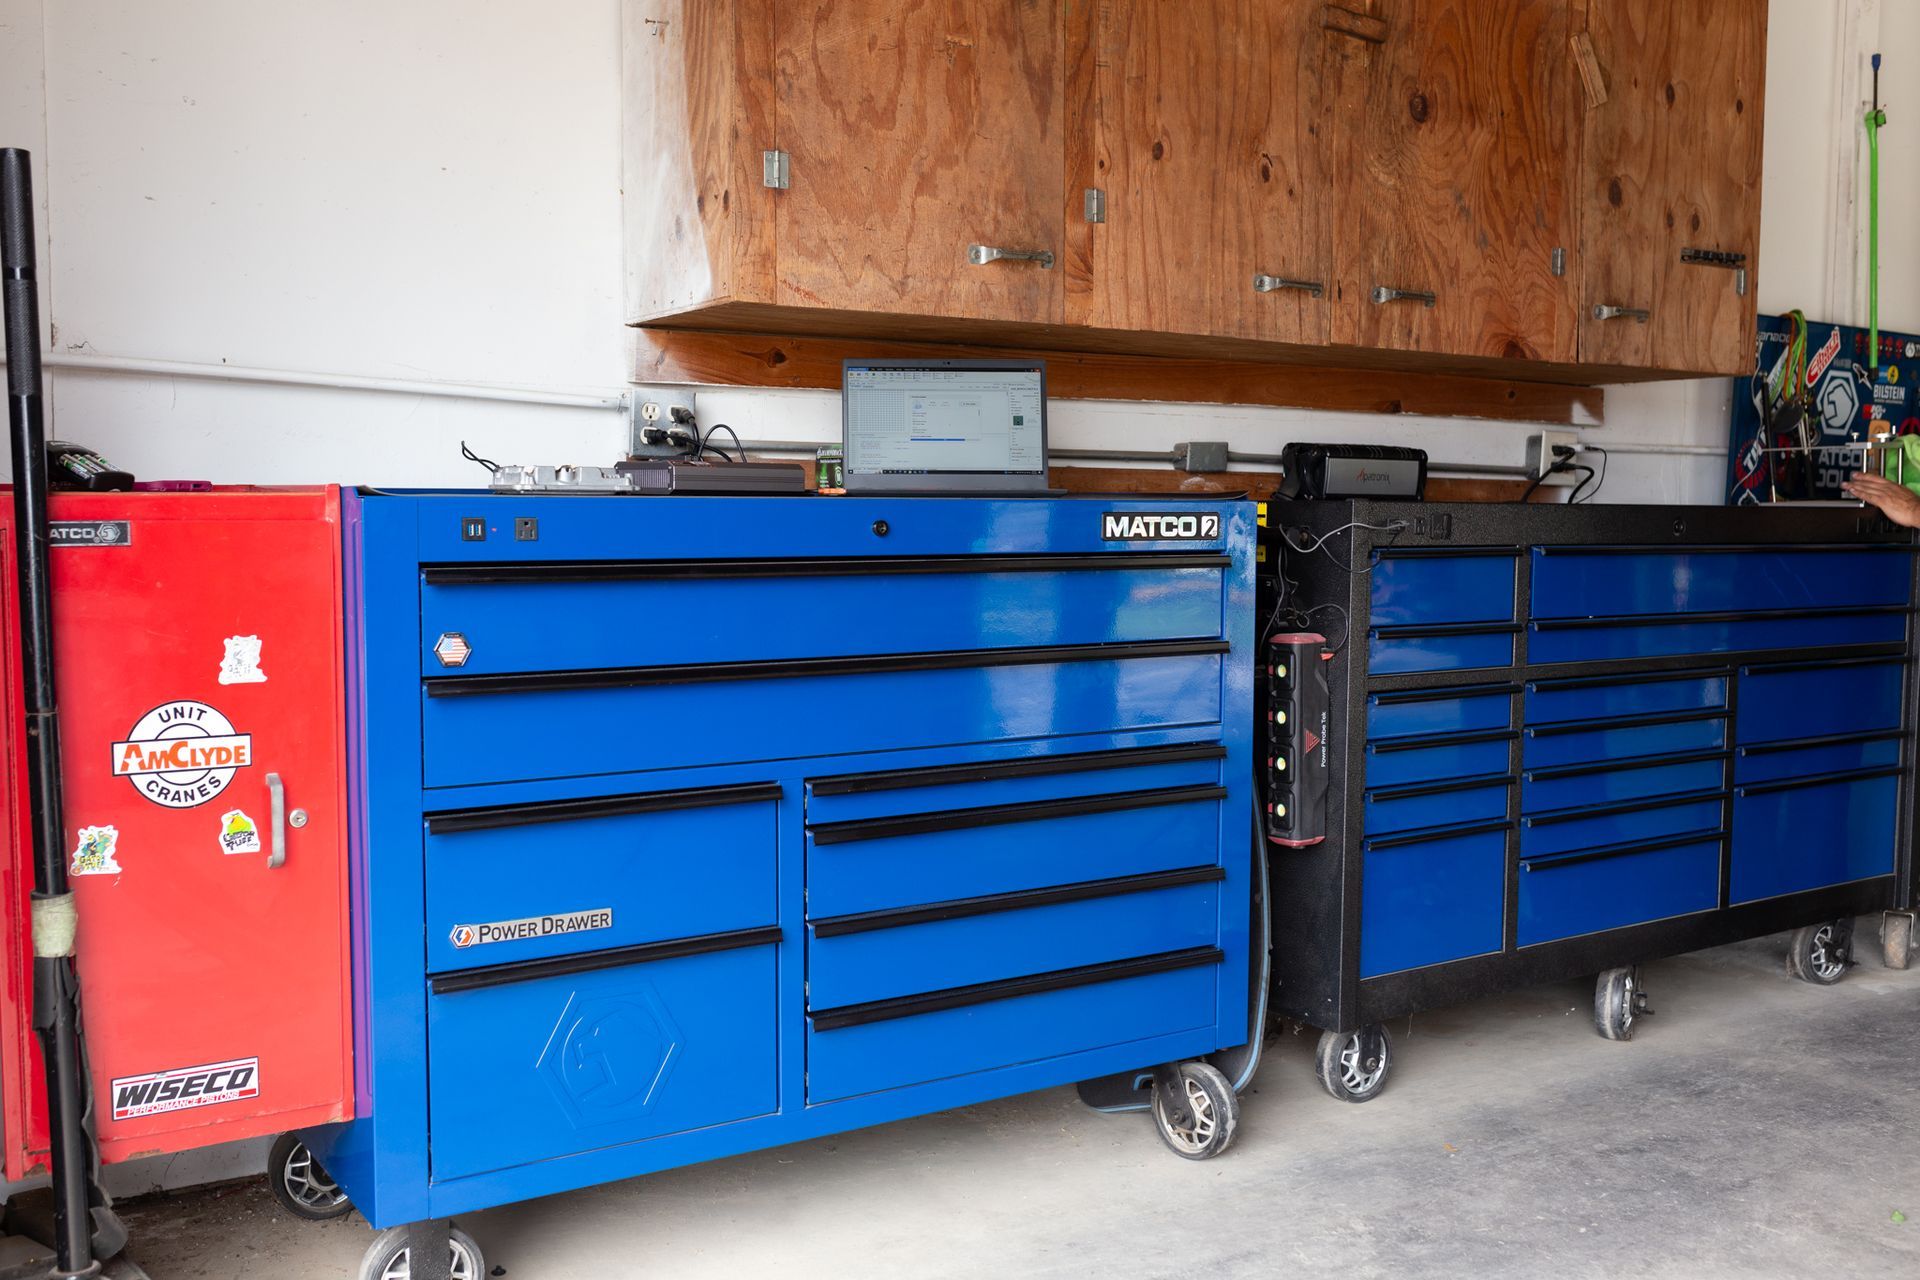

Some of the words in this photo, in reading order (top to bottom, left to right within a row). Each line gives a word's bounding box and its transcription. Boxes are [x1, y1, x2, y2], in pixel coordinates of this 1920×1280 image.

[1807, 330, 1840, 384] Eibach
[1873, 384, 1906, 400] BILSTEIN
[1818, 448, 1863, 467] ATCO
[49, 528, 95, 540] ATCO
[1105, 515, 1198, 538] MATCO
[158, 706, 208, 724] UNIT
[146, 776, 222, 803] CRANES
[478, 922, 538, 943] POWER
[542, 912, 610, 935] DRAWER
[116, 1066, 254, 1109] WISECO
[128, 1097, 198, 1116] PERFORMANCE
[201, 1091, 240, 1104] PISTONS
